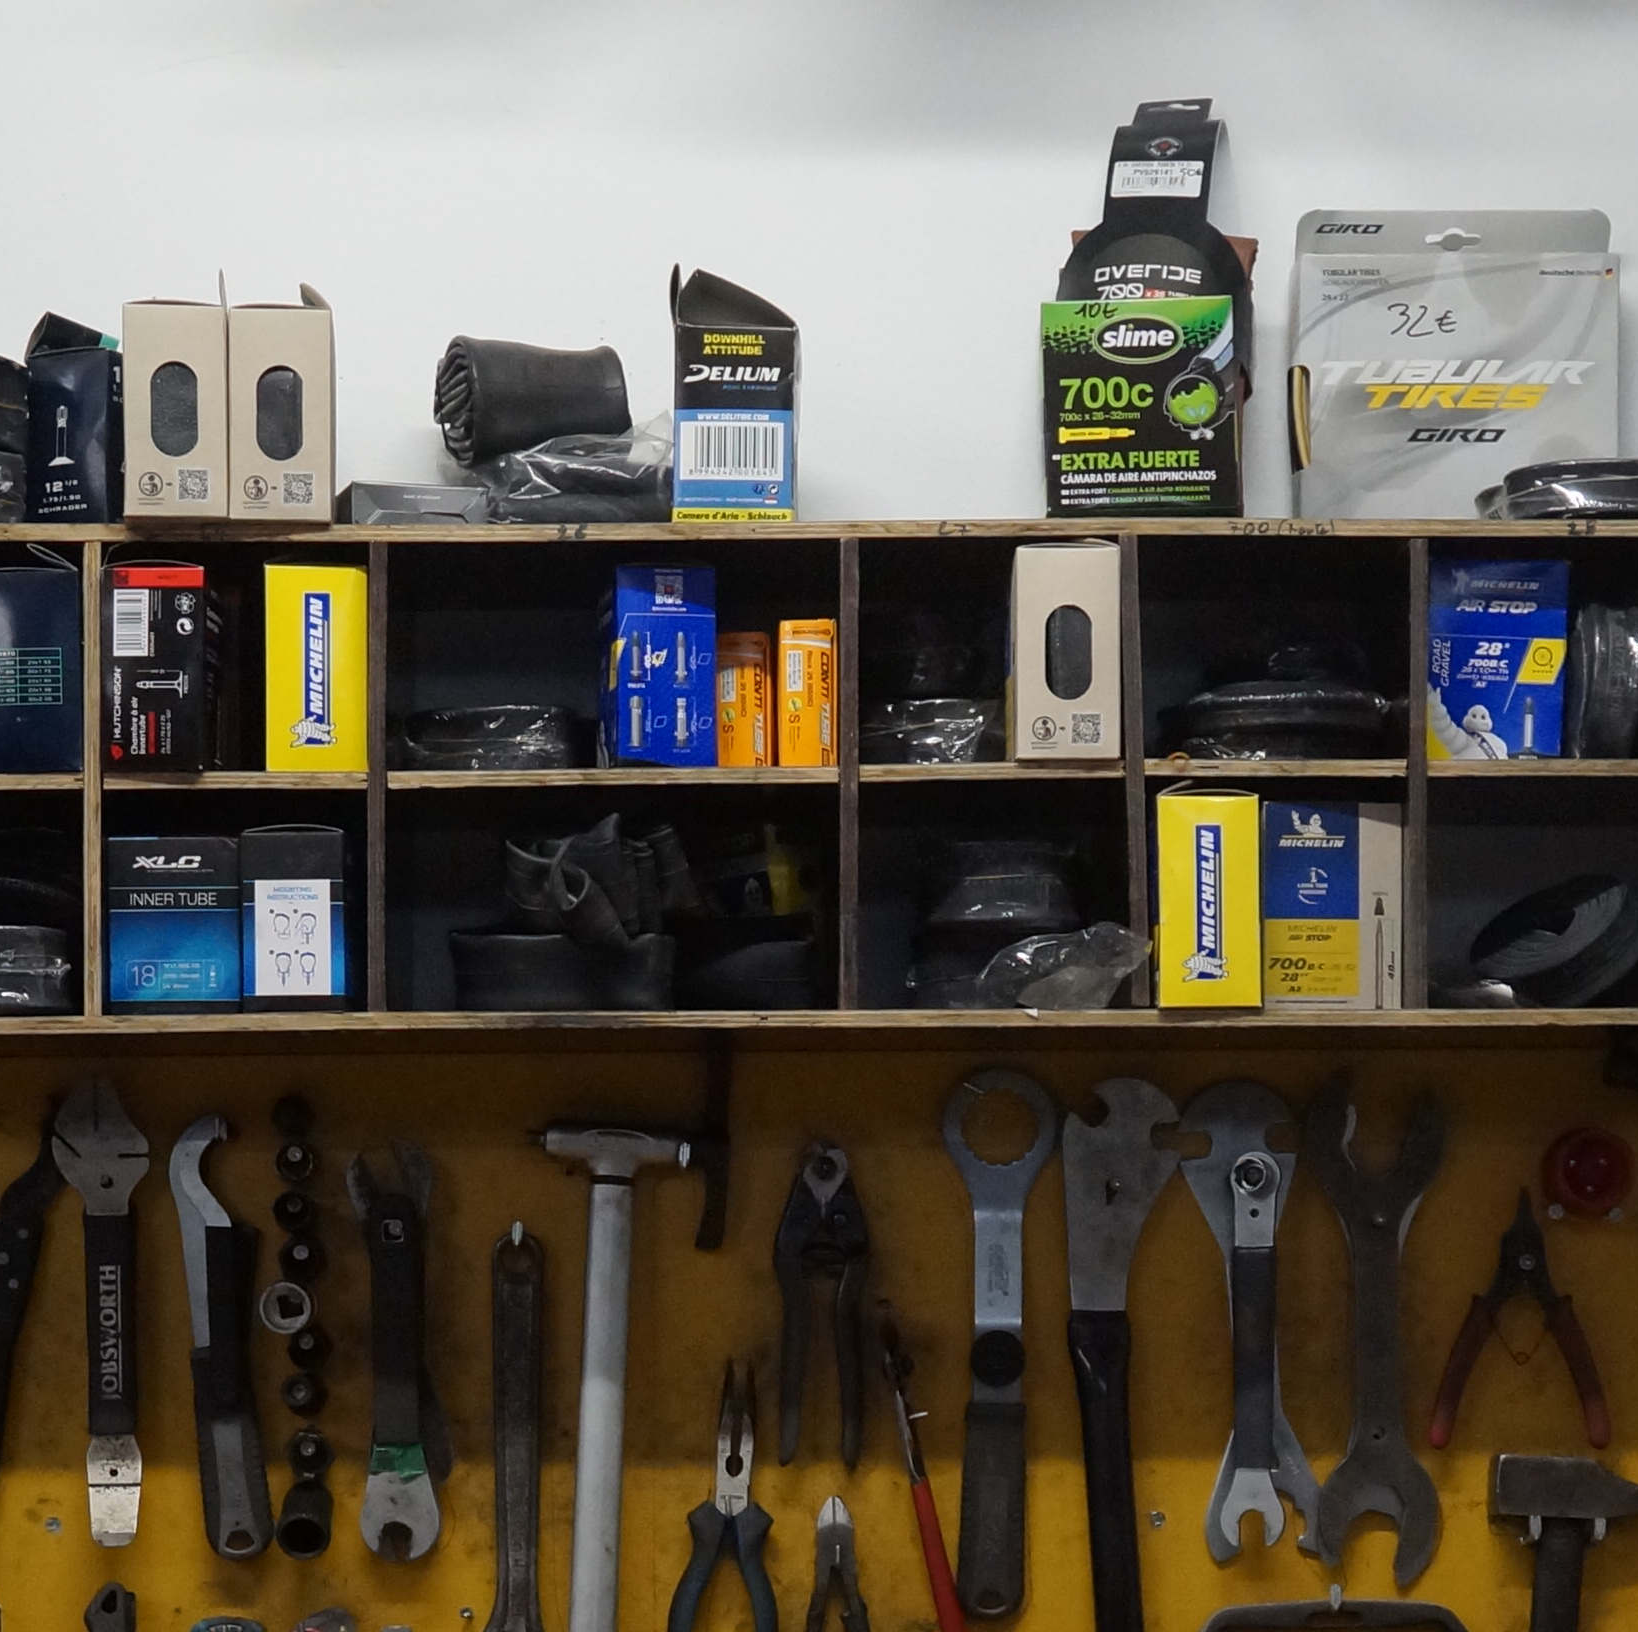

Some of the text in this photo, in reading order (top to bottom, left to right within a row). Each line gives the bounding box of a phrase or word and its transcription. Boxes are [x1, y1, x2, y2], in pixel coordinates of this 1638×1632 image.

[1315, 223, 1384, 234] GIRO
[1093, 264, 1202, 285] OVERIDE
[1097, 283, 1144, 300] 700
[703, 333, 765, 345] DOWNHILL
[1101, 323, 1175, 348] slime
[702, 345, 762, 355] ATTITUDE
[683, 364, 781, 383] DELIUM
[1321, 360, 1595, 385] TUBULAR
[1059, 376, 1154, 409] 700c
[1364, 383, 1549, 409] TIRES
[1059, 413, 1082, 422] 700c
[1407, 428, 1507, 443] GIRO
[1061, 450, 1200, 471] EXTRA FUERTE
[45, 481, 63, 493] 12
[1060, 470, 1217, 485] CÁMARA DE AIRE ANTIPINCHAZOS
[677, 511, 710, 520] Camera
[747, 511, 788, 521] Schlauch
[1470, 580, 1540, 591] MICHELIN
[1456, 599, 1538, 614] AIR STOP
[309, 597, 324, 715] MICHELIN
[1432, 639, 1441, 673] ROAD
[1440, 640, 1451, 687] GRAVEL
[821, 651, 829, 698] CONTI
[753, 663, 763, 711] CONTI
[113, 668, 122, 738] HUTCHINSON
[723, 724, 734, 734] S
[789, 714, 800, 724] S
[131, 719, 139, 754] Chambre
[138, 714, 147, 754] Innertube
[1278, 838, 1345, 849] MICHELIN
[132, 855, 202, 869] XLC
[129, 892, 218, 906] INNER TUBE
[1201, 829, 1216, 950] MICHELIN
[131, 965, 156, 987] 18
[99, 1264, 121, 1400] JOBSWORTH
